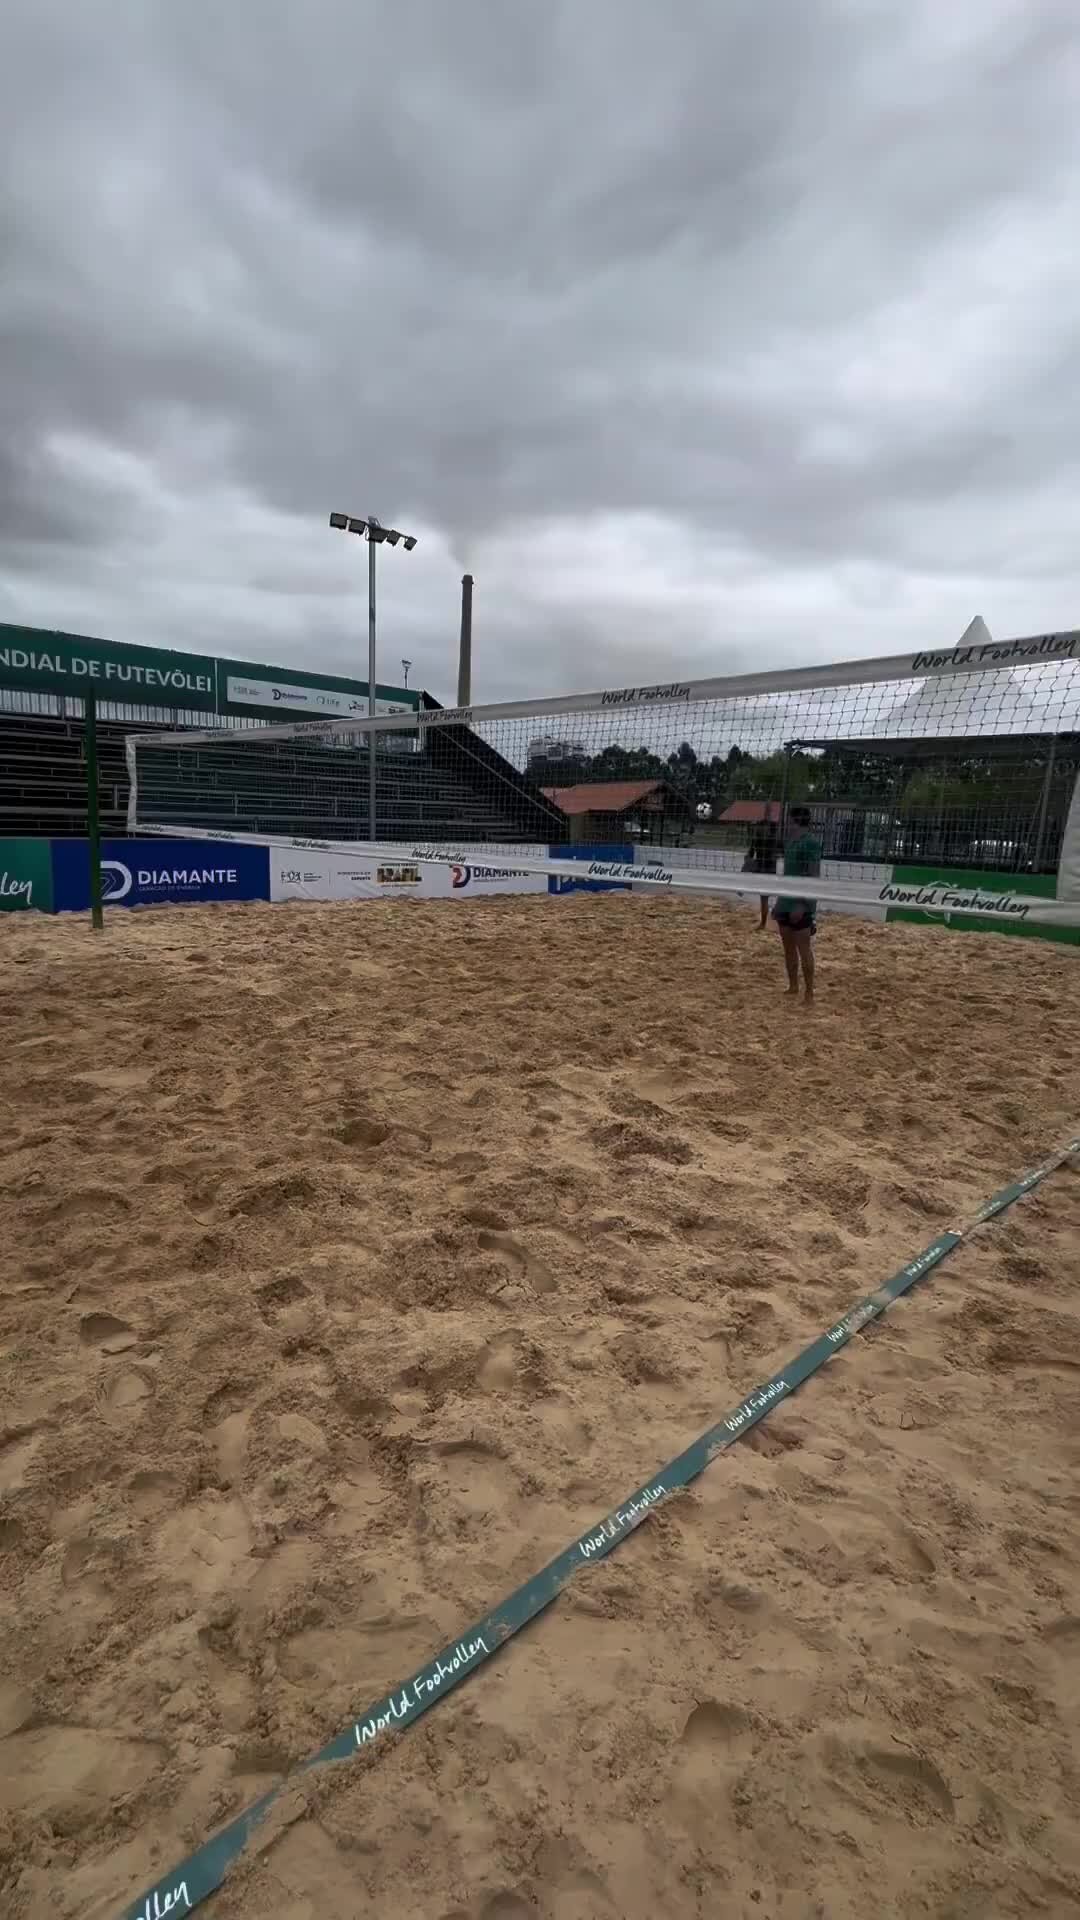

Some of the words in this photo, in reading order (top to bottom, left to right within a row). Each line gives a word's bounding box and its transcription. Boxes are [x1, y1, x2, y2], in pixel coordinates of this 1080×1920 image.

[911, 646, 973, 671] World
[979, 635, 1077, 662] Footvolley
[71, 657, 100, 678] DE
[105, 662, 211, 692] FUTEVÔLEI
[601, 687, 635, 704] World
[638, 683, 691, 701] Footvolley
[138, 869, 237, 885] DIAMANTE
[588, 862, 622, 877] World
[623, 865, 673, 884] Footvolley
[878, 884, 937, 905] World
[941, 890, 1030, 921] Footvolley
[724, 1406, 754, 1432] World
[749, 1379, 791, 1416] Footvolley
[579, 1519, 620, 1558] World
[615, 1483, 668, 1527] Footvolley
[354, 1691, 415, 1745] World
[413, 1635, 491, 1703] Footvolley
[136, 1881, 193, 1920] lley
